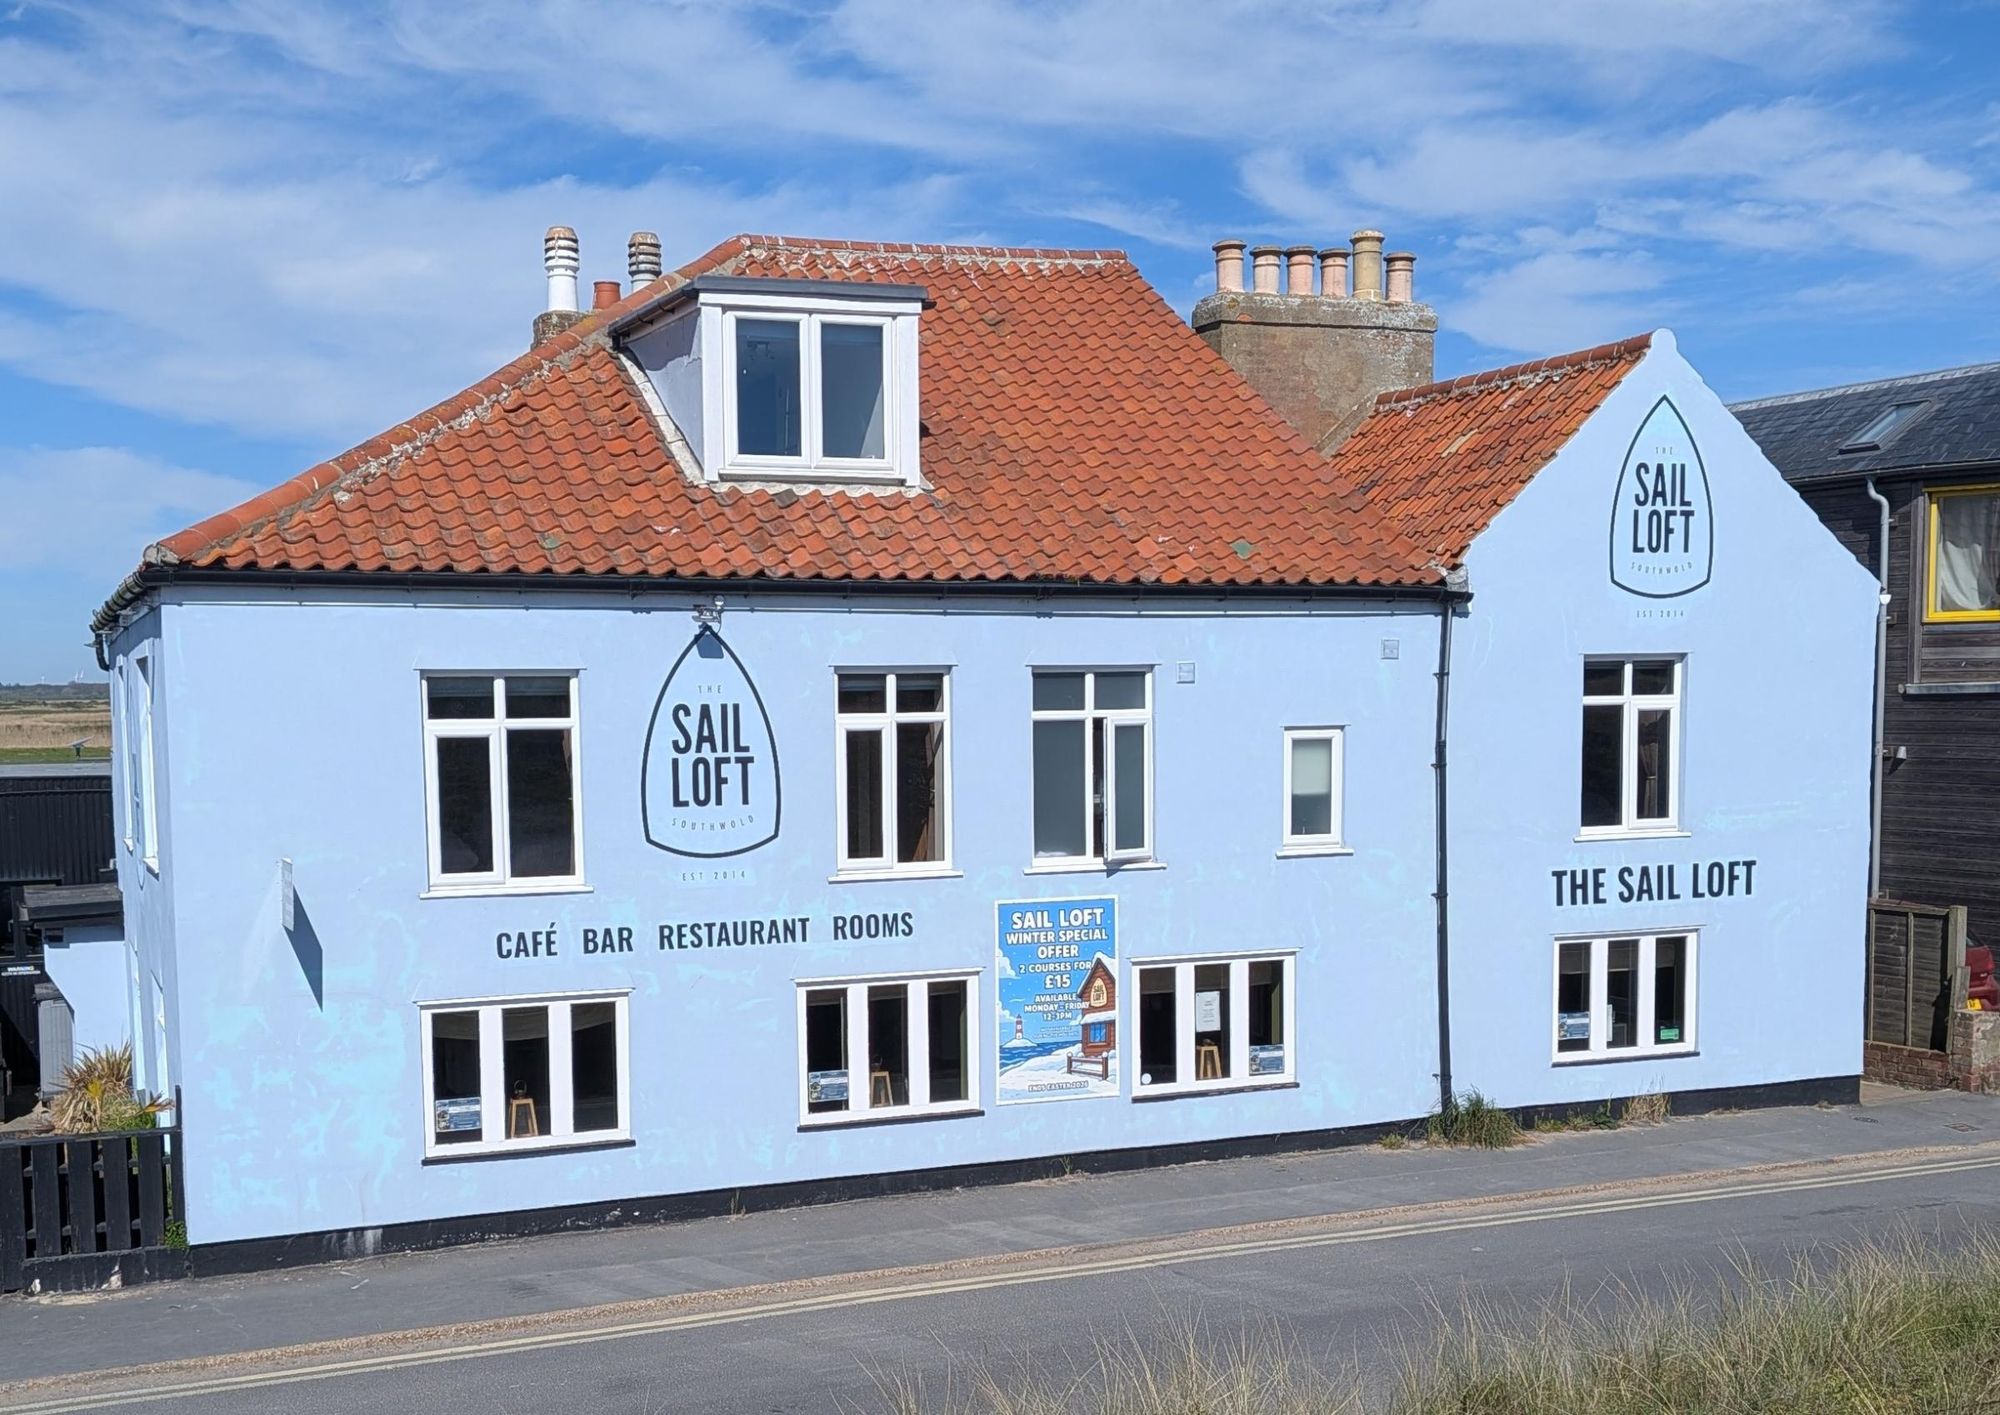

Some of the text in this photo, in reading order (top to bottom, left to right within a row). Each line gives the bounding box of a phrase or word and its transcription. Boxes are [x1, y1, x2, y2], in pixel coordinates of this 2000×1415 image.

[1634, 462, 1692, 507] SAIL
[1632, 508, 1695, 554] LOFT
[697, 685, 722, 694] THE
[671, 703, 750, 754] SAIL
[671, 756, 754, 807] LOFT
[671, 814, 754, 831] SOUTHWOLD
[682, 870, 746, 882] EST 2014
[1551, 860, 1757, 906] THE SAIL LOFT
[1011, 907, 1104, 929] SAIL LOFT
[496, 912, 914, 959] CAFÉ BAR RESTAURANT ROOMS
[1006, 928, 1108, 945] WINTER SPECIAL
[1037, 945, 1079, 958] OFFER
[1019, 961, 1092, 973] 2 COURSES FOR
[1045, 974, 1071, 989] £15
[1035, 993, 1077, 1002] AVAILABLE
[1024, 1003, 1058, 1012] MONDAY
[1065, 1001, 1090, 1010] FRIDAY
